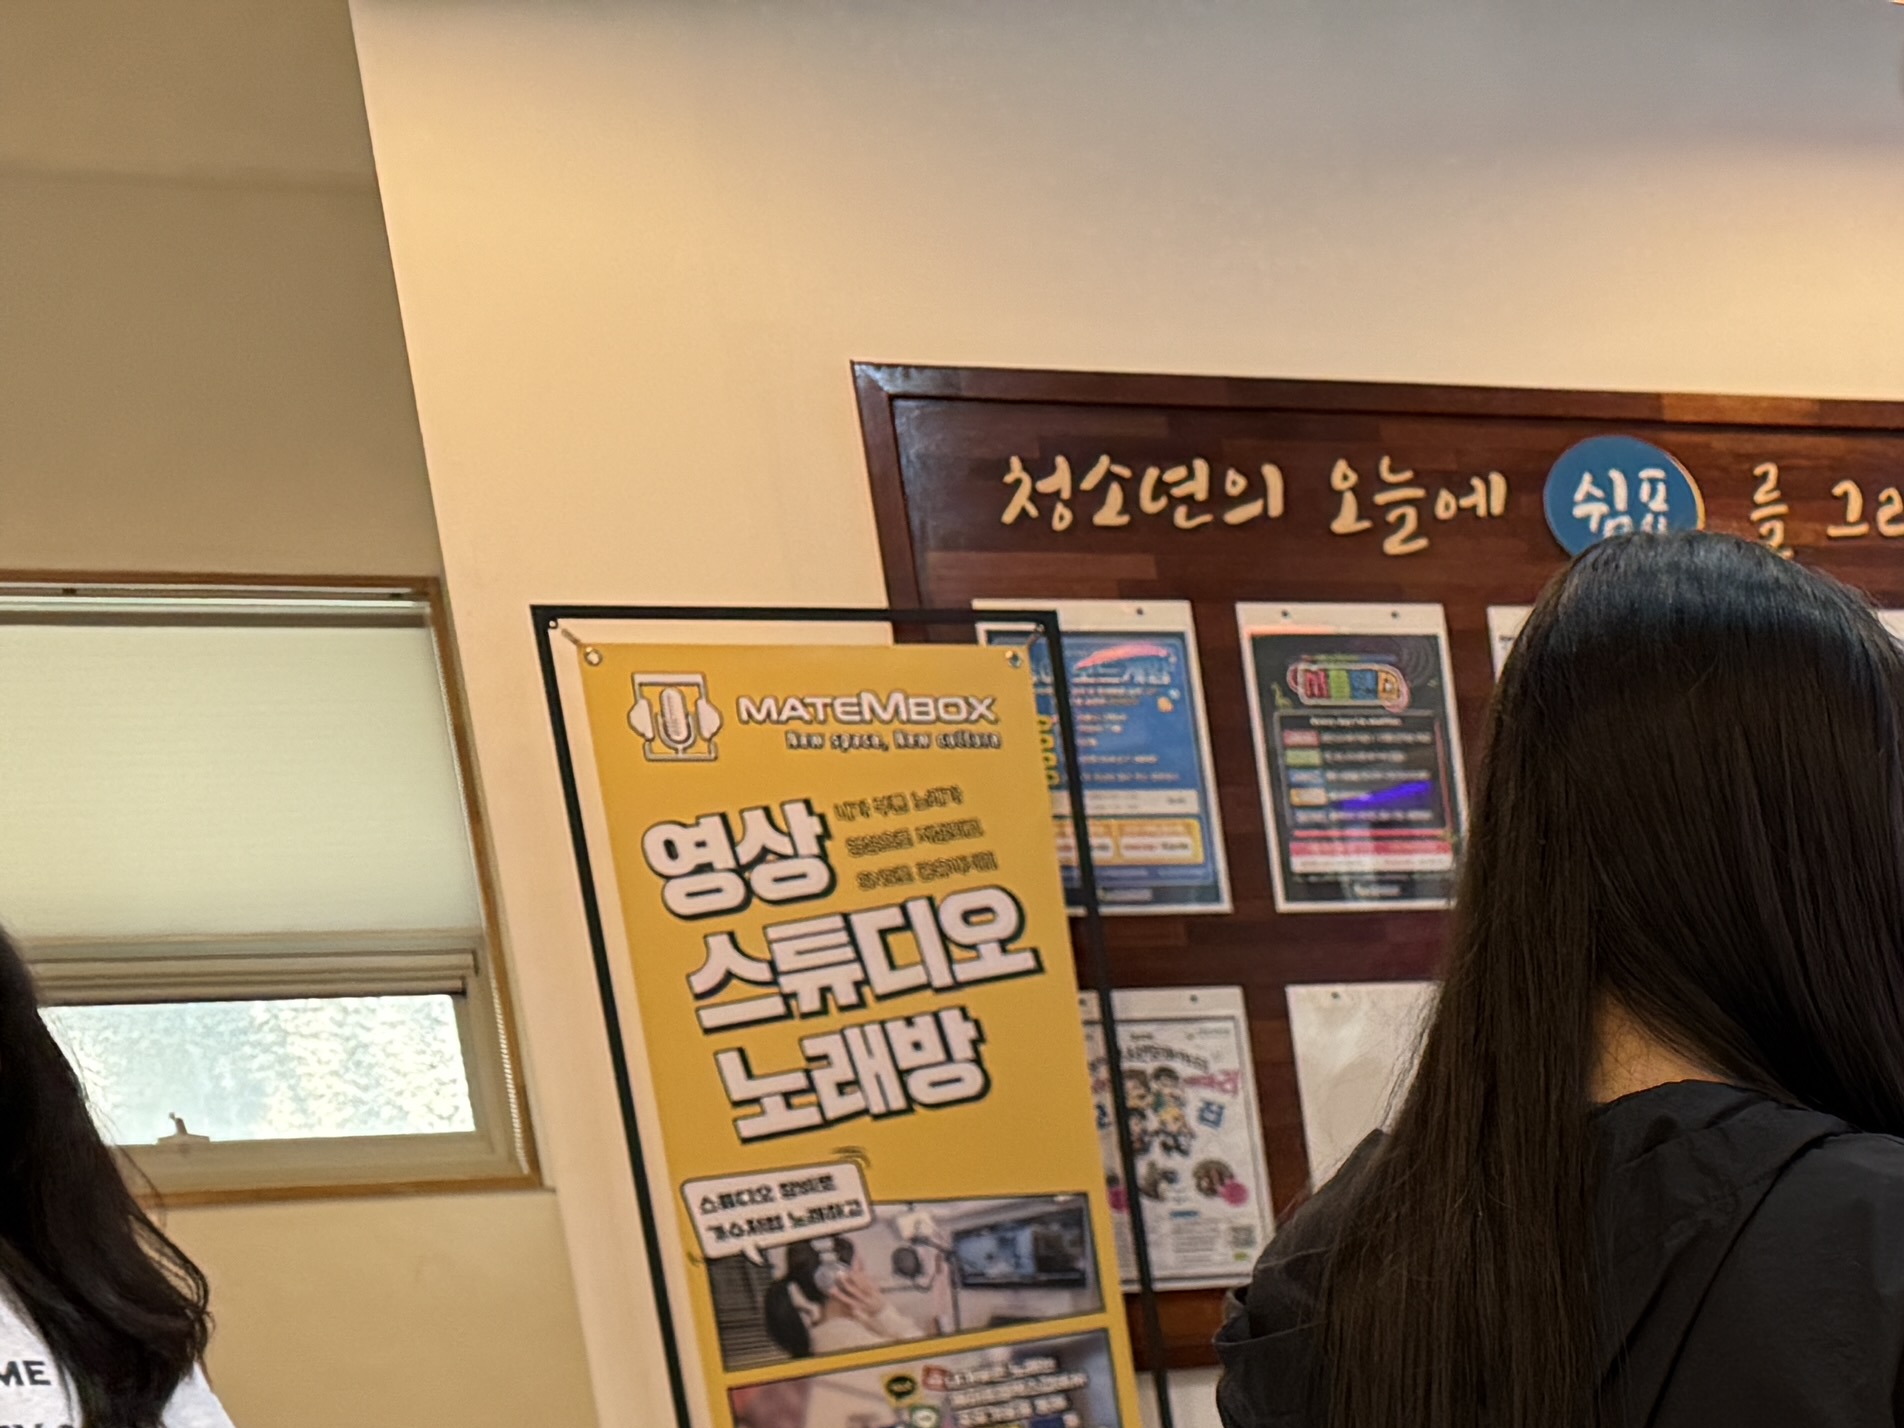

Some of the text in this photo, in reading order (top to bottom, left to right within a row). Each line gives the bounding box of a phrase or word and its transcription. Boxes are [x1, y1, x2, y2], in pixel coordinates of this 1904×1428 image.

[1000, 454, 1284, 532] 청소년의
[1329, 455, 1507, 556] 오늘에
[1750, 461, 1796, 560] 를
[736, 690, 999, 725] MATEMBOX
[641, 798, 837, 921] 영상
[686, 884, 1045, 1036] 스튜디오
[714, 1006, 992, 1144] 노래방
